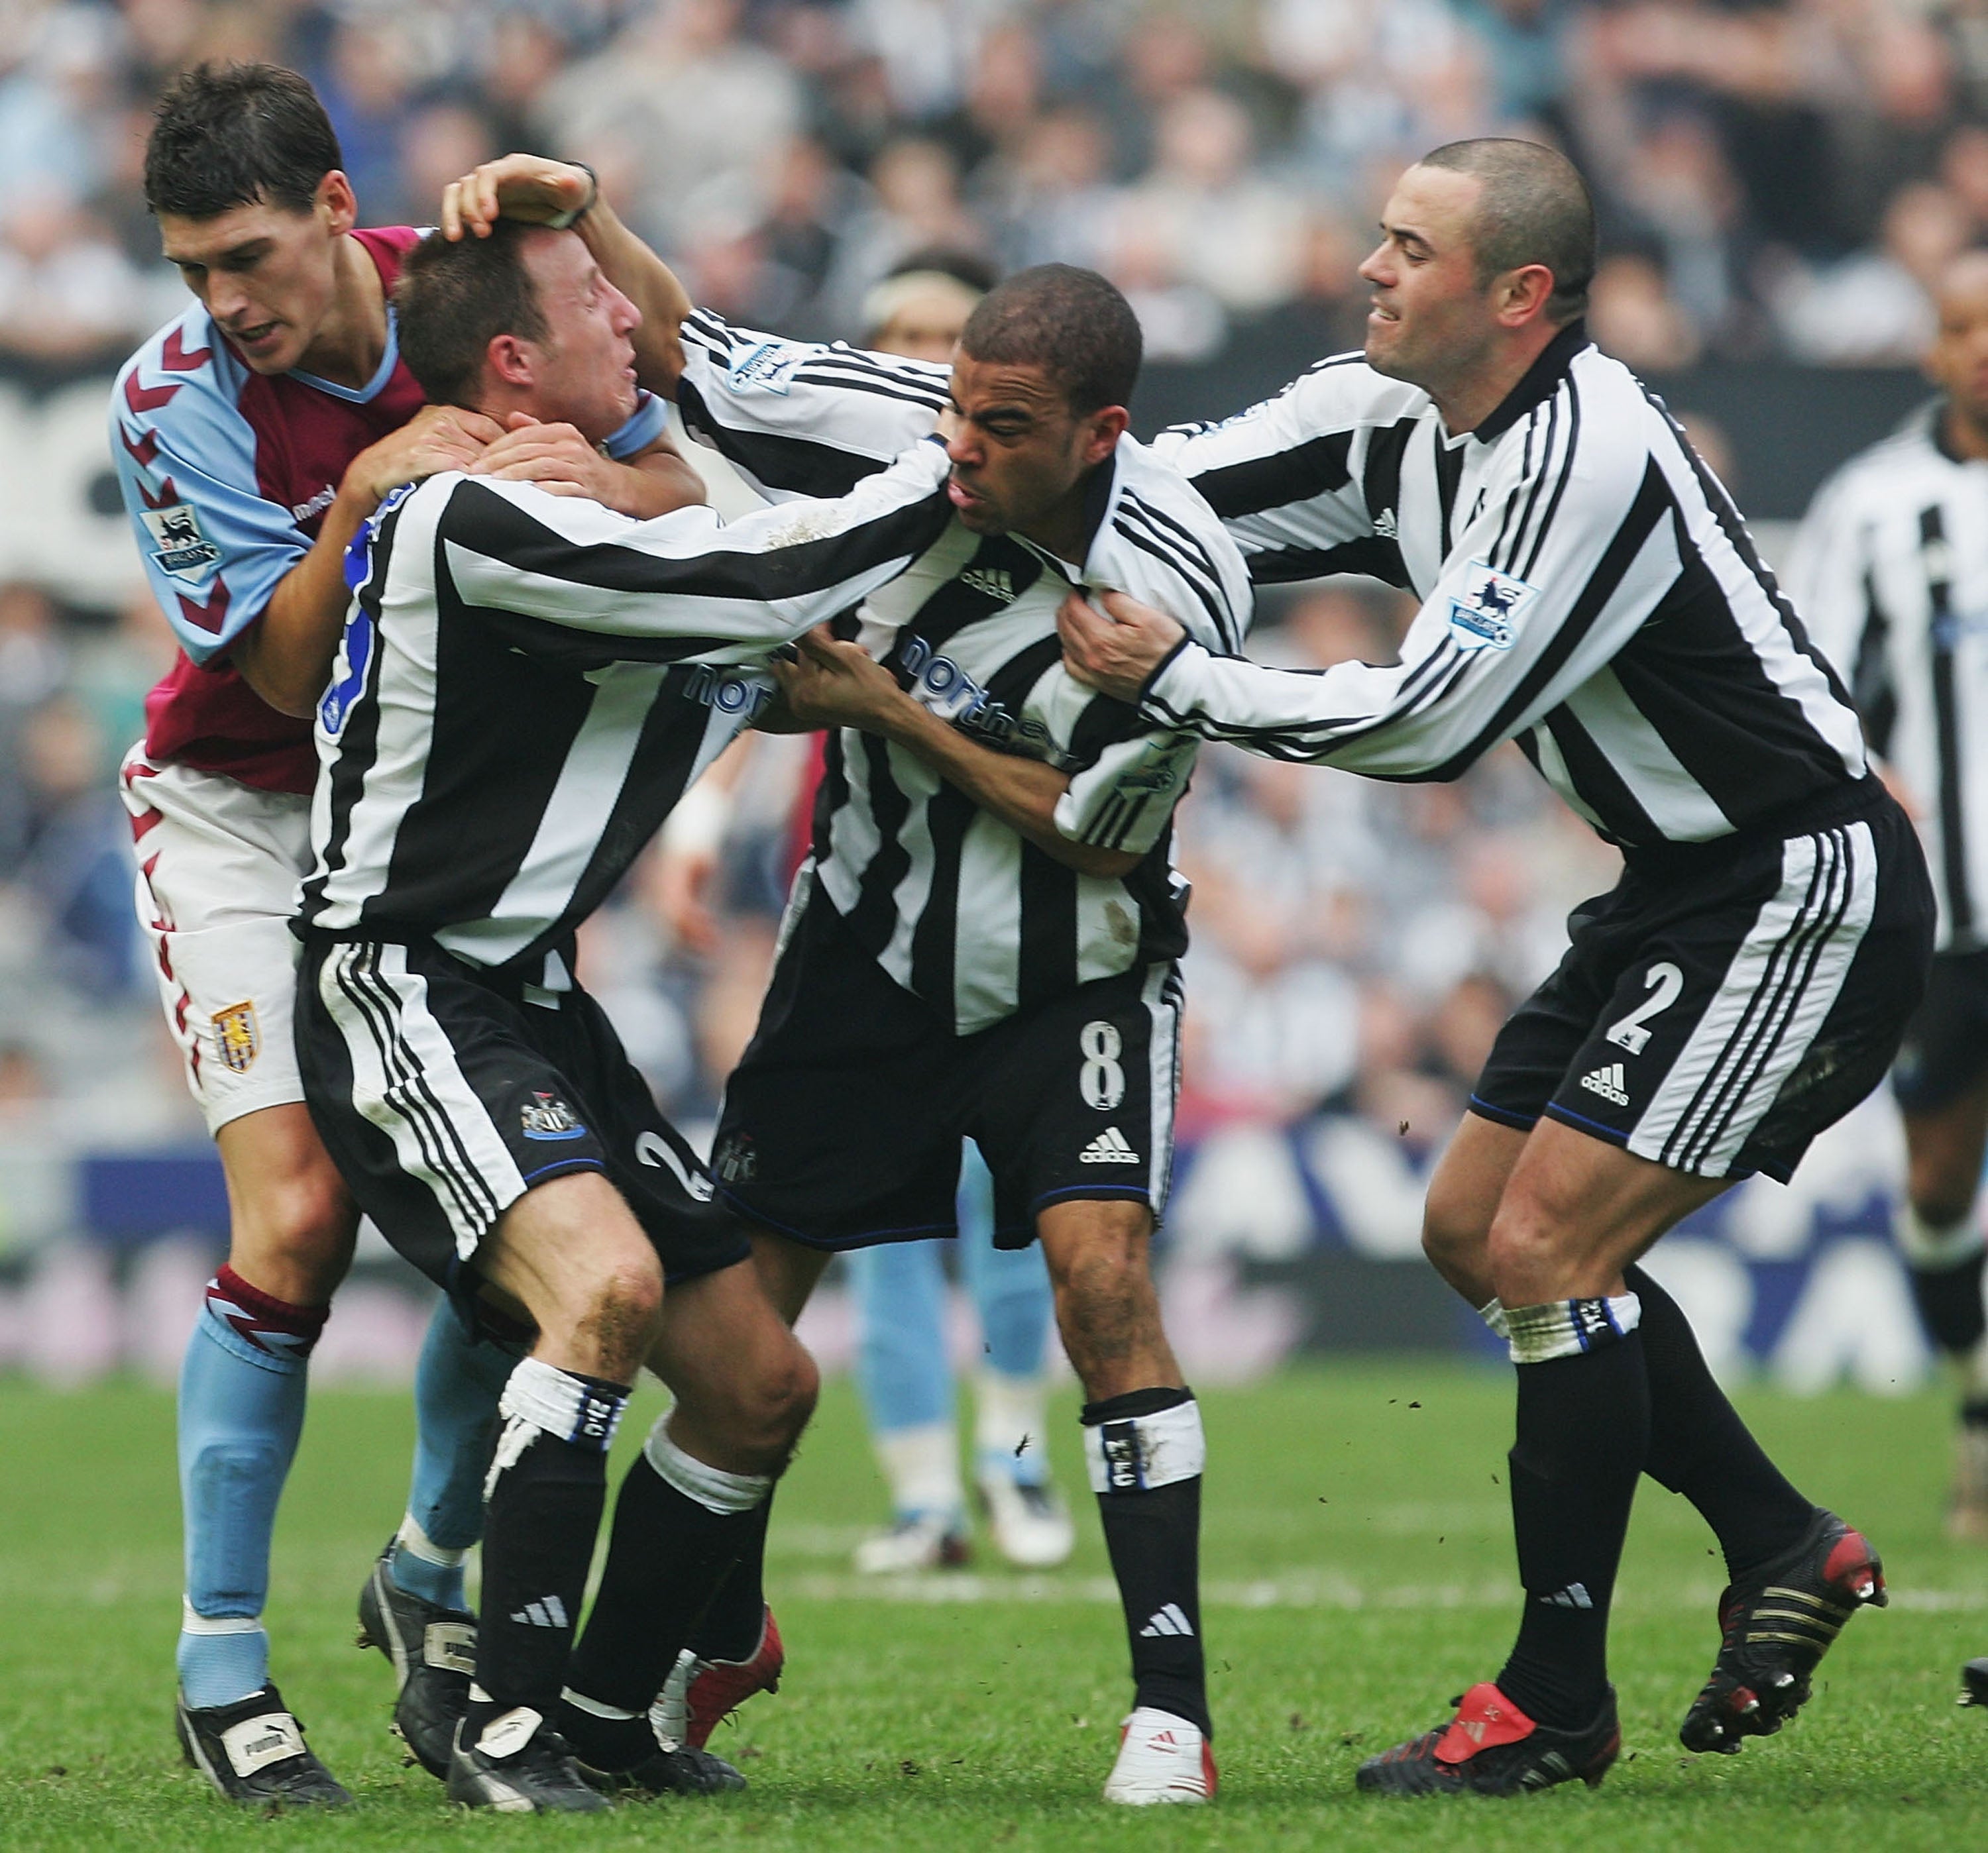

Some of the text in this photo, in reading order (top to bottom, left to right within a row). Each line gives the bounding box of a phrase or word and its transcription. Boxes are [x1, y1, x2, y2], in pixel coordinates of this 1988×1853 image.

[1606, 961, 1684, 1055] 2
[1079, 1020, 1125, 1110] 8
[1580, 1075, 1629, 1106] adidas
[1079, 1151, 1140, 1163] adidas
